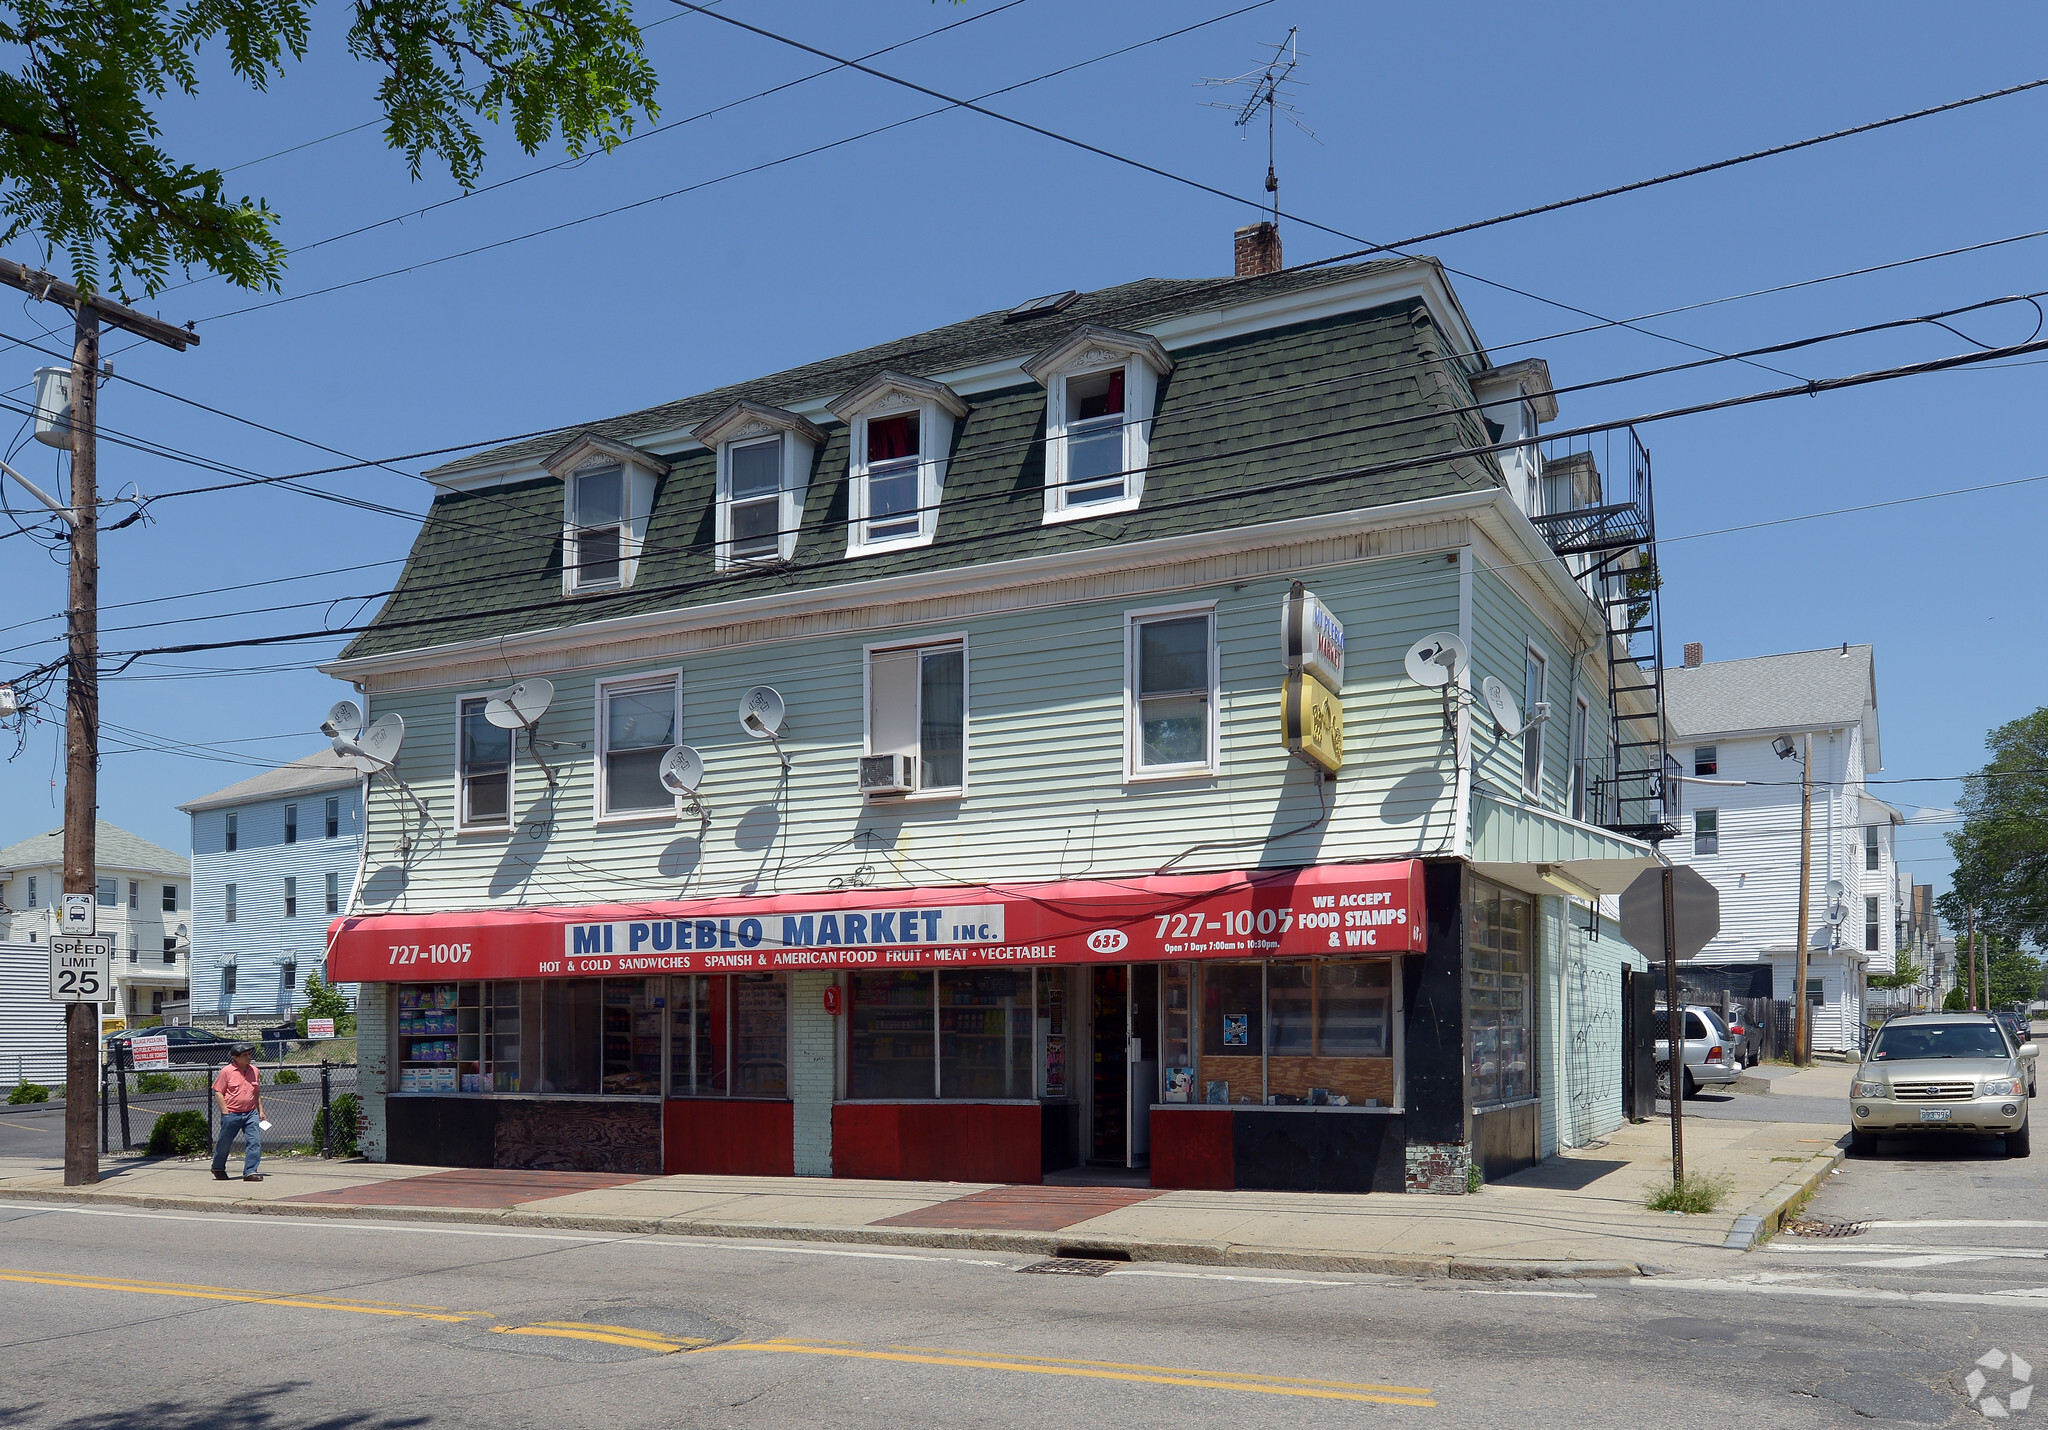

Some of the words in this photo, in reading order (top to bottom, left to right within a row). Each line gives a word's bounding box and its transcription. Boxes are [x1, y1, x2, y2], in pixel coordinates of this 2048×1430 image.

[1317, 631, 1341, 669] MARKET
[1312, 895, 1335, 908] WE
[1339, 892, 1392, 907] ACCEPT
[1154, 907, 1294, 939] 727-1005
[1298, 911, 1340, 930] FOOD
[1345, 908, 1407, 927] STAMPS
[573, 924, 613, 955] MI
[629, 918, 763, 952] PUEBLO
[782, 909, 942, 947] MARKET
[952, 923, 998, 941] INC.
[1092, 934, 1121, 949] 635
[1328, 931, 1340, 947] &
[1345, 929, 1377, 946] WIC
[53, 943, 106, 955] SPEED
[388, 943, 472, 965] 727-1005
[1164, 943, 1183, 954] Open
[1184, 942, 1189, 951] 7
[1190, 942, 1208, 953] Days
[1209, 941, 1236, 951] 7:00am
[1237, 941, 1245, 950] to
[1247, 939, 1280, 951] 10:30pm.
[61, 957, 97, 967] LIMIT
[539, 961, 561, 973] HOT
[567, 961, 576, 972] &
[580, 959, 612, 971] COLD
[619, 956, 691, 970] SANDWICHES
[704, 954, 752, 967] SPANISH
[757, 953, 767, 965] &
[773, 950, 837, 965] AMERICAN
[839, 950, 877, 963] FOOD
[886, 949, 922, 962] FRUIT
[934, 948, 969, 961] MEAT
[979, 945, 1057, 960] VEGETABLE
[58, 970, 100, 994] 25
